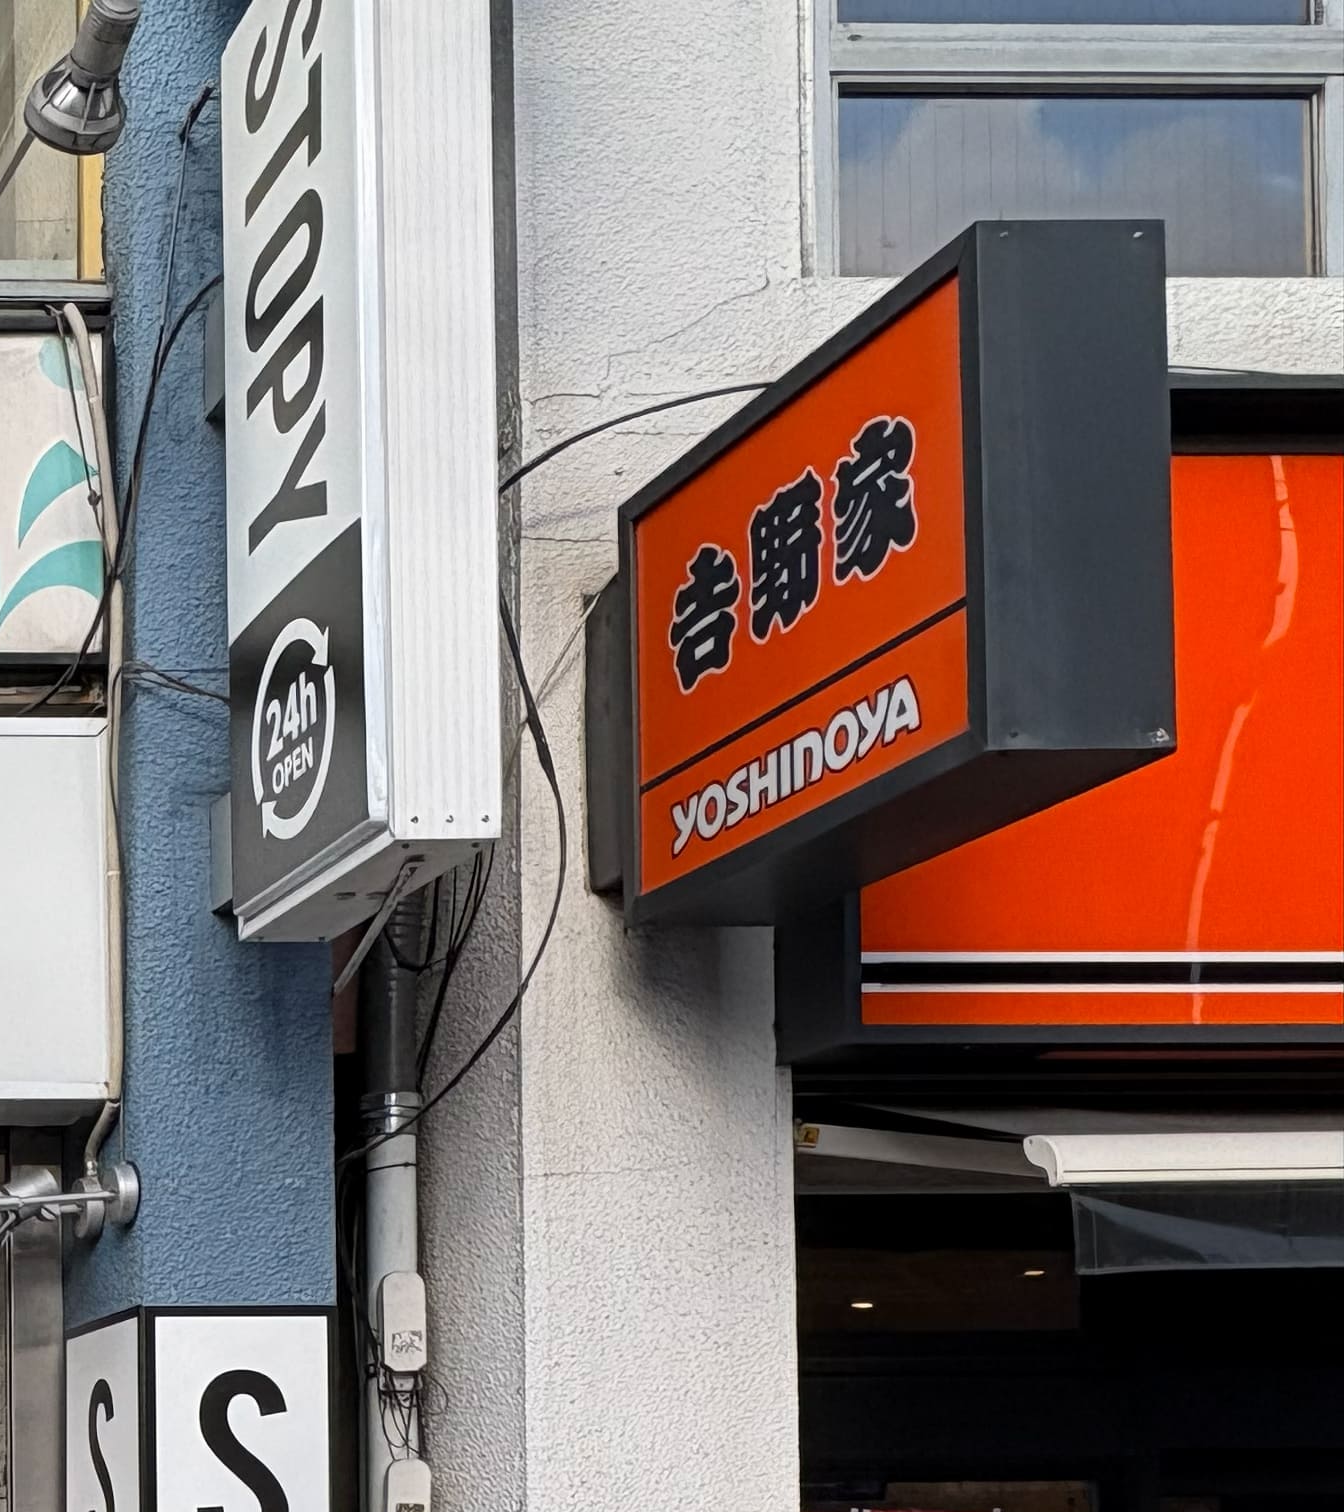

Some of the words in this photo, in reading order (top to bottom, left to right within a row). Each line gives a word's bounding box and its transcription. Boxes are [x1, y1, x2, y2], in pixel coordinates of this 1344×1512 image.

[245, 0, 327, 556] STOPY
[669, 415, 918, 695] 吉野家
[266, 671, 317, 761] 24h
[272, 736, 313, 794] OPEN
[671, 676, 921, 858] YOSHINOYA
